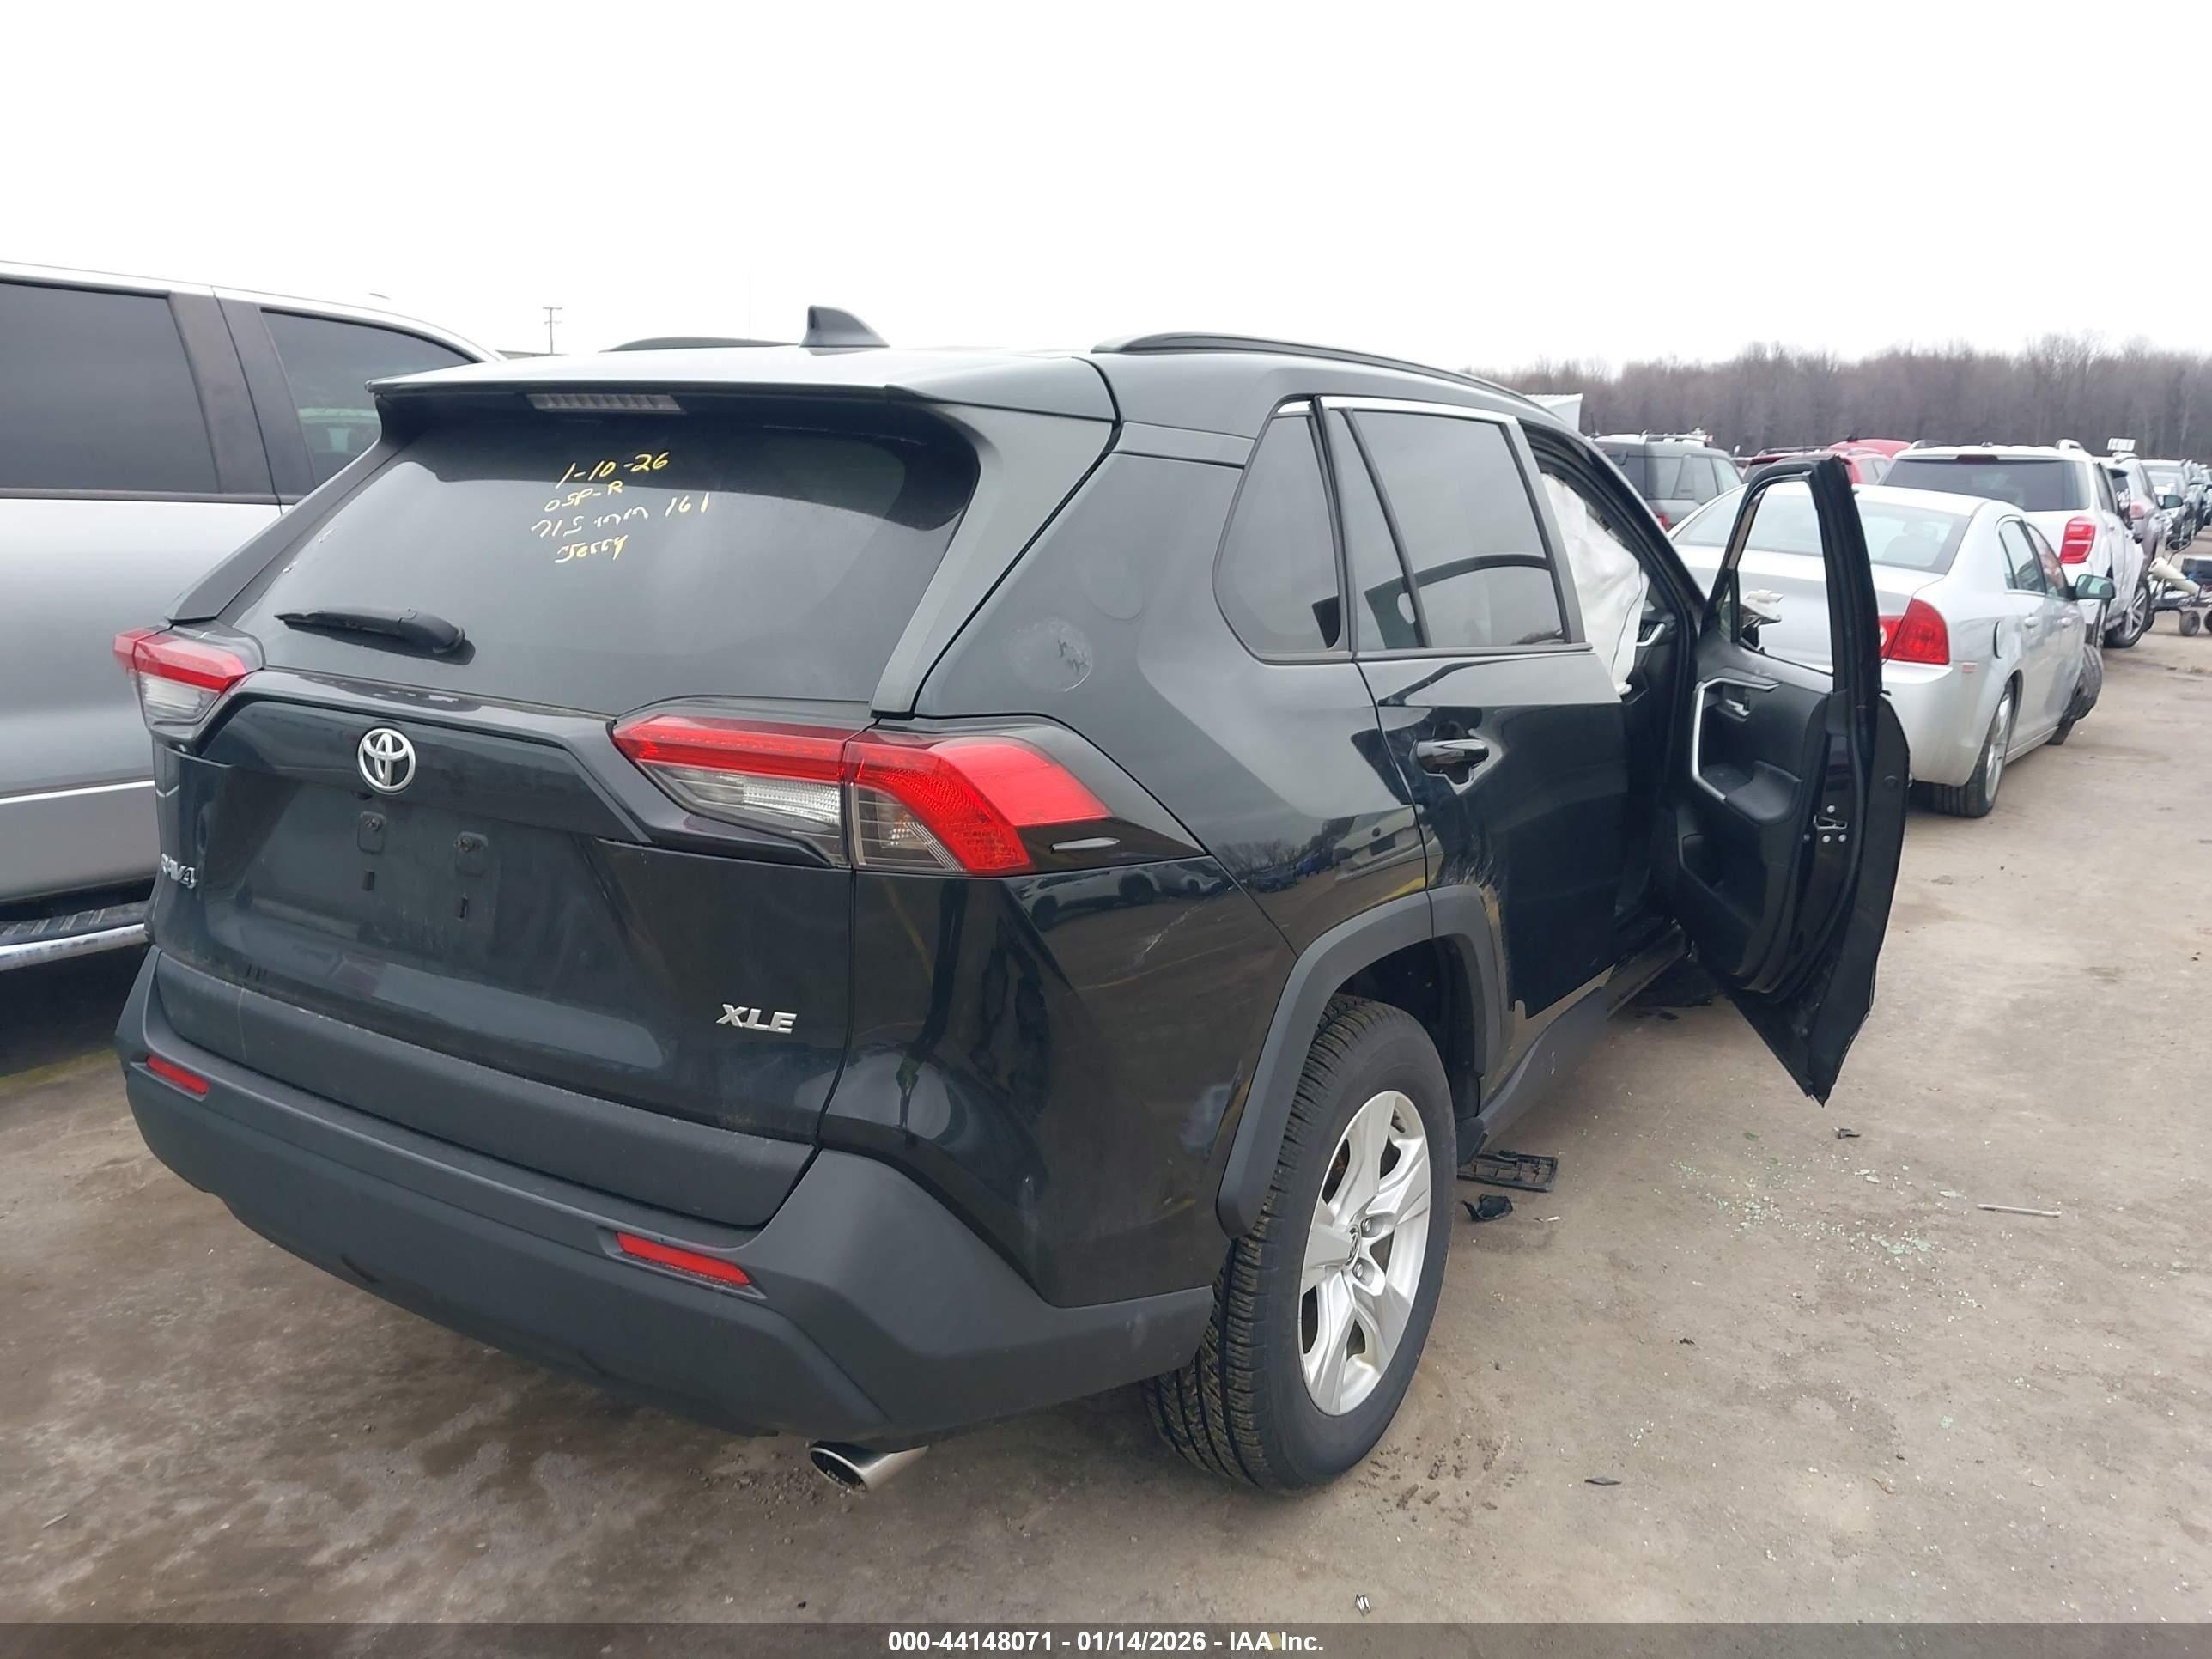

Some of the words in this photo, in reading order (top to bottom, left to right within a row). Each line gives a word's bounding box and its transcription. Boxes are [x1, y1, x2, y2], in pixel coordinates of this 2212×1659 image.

[555, 452, 670, 489] 1-10-26
[665, 490, 710, 518] 161
[715, 1003, 798, 1035] XLE
